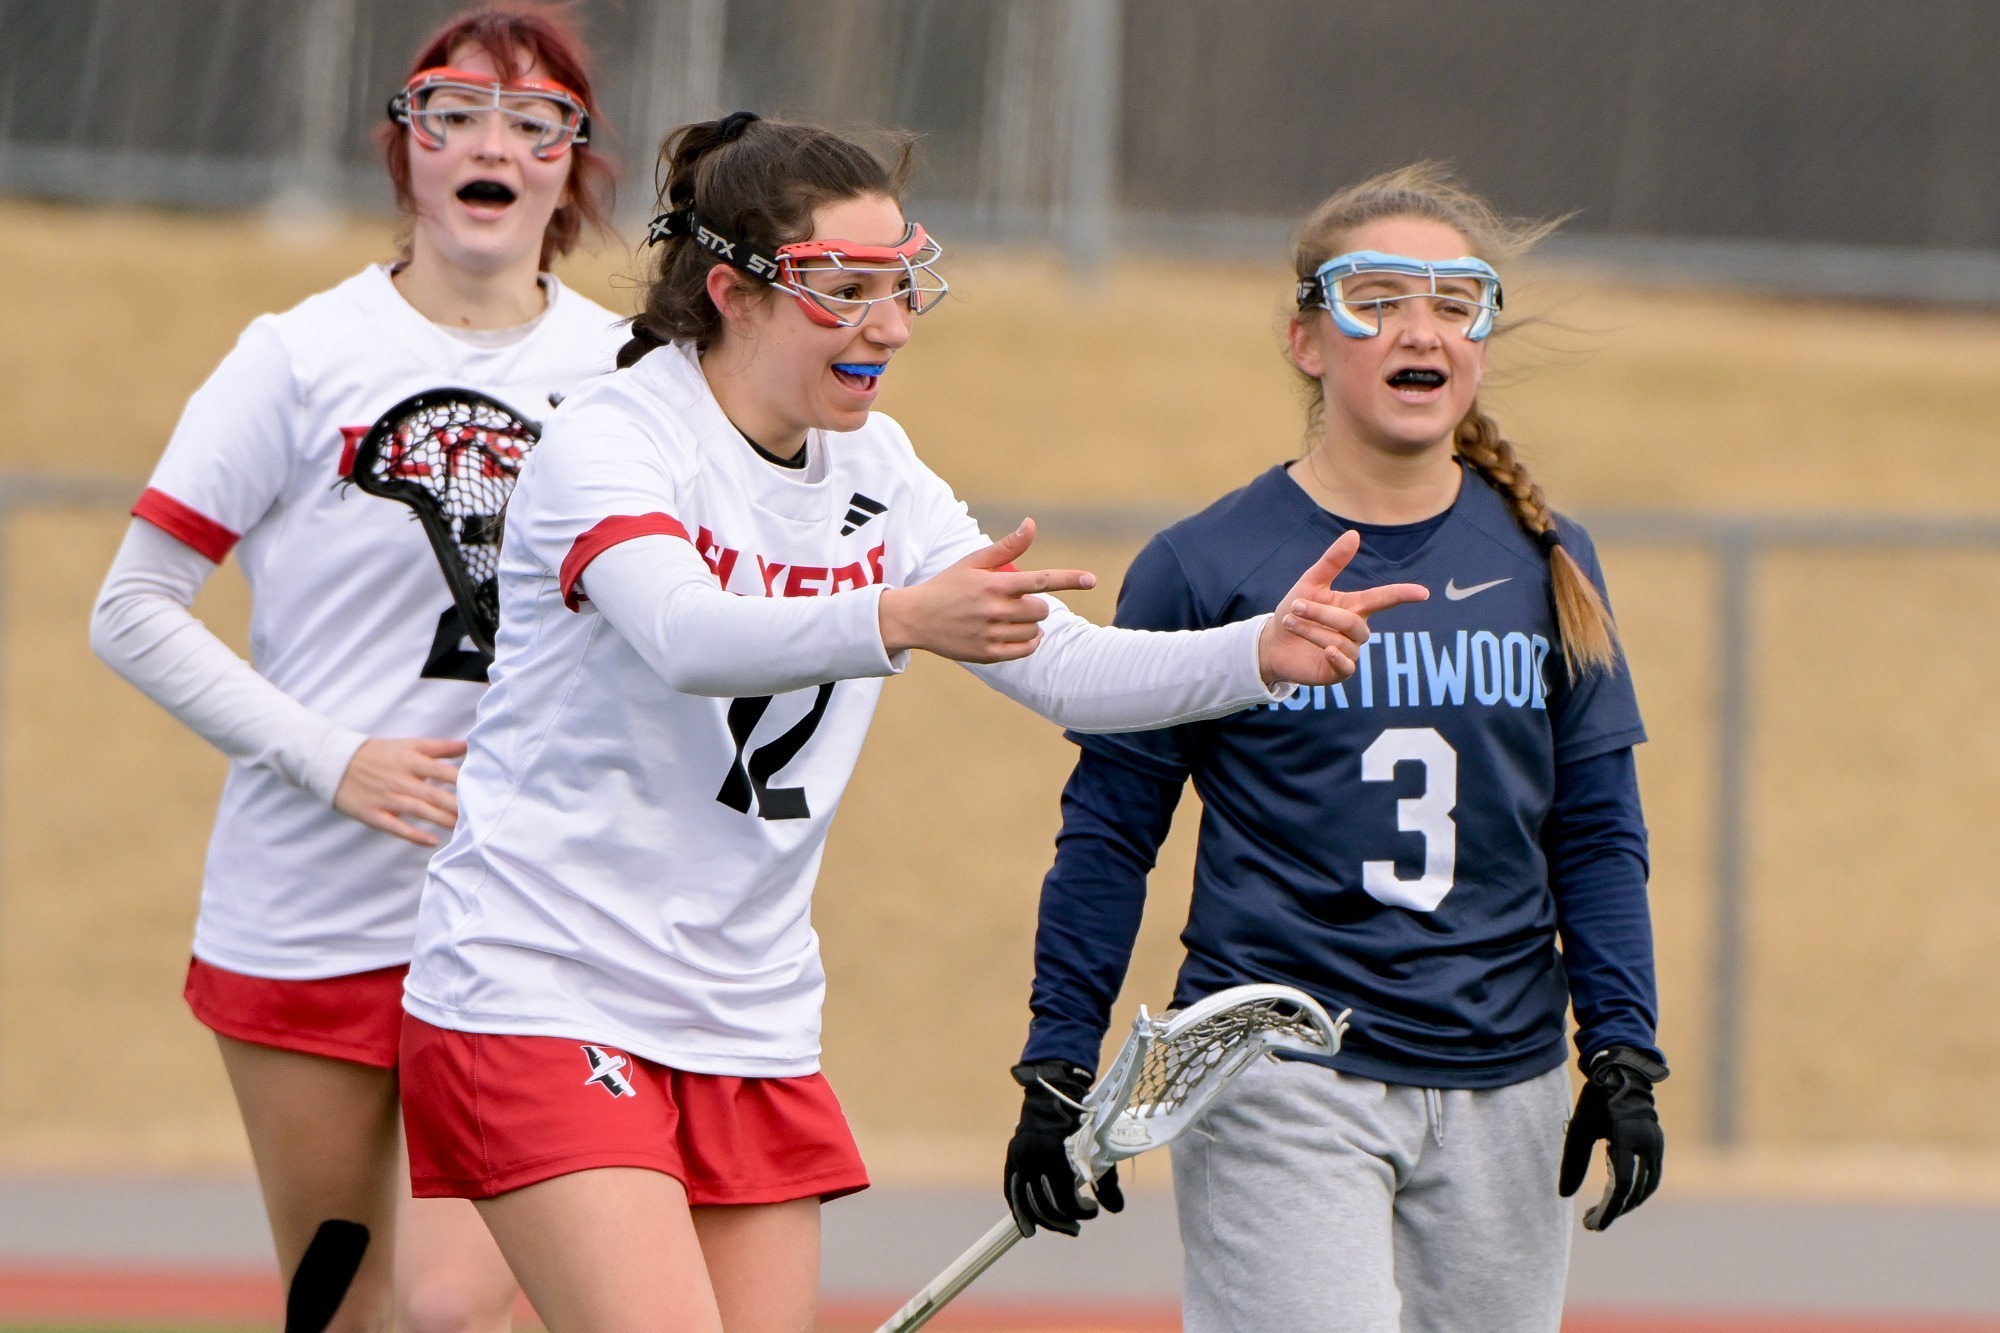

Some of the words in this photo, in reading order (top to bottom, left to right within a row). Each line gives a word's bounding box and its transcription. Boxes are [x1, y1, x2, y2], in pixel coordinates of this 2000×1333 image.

[697, 225, 736, 260] STX
[1248, 629, 1550, 711] THWOOD
[1361, 727, 1457, 912] 3
